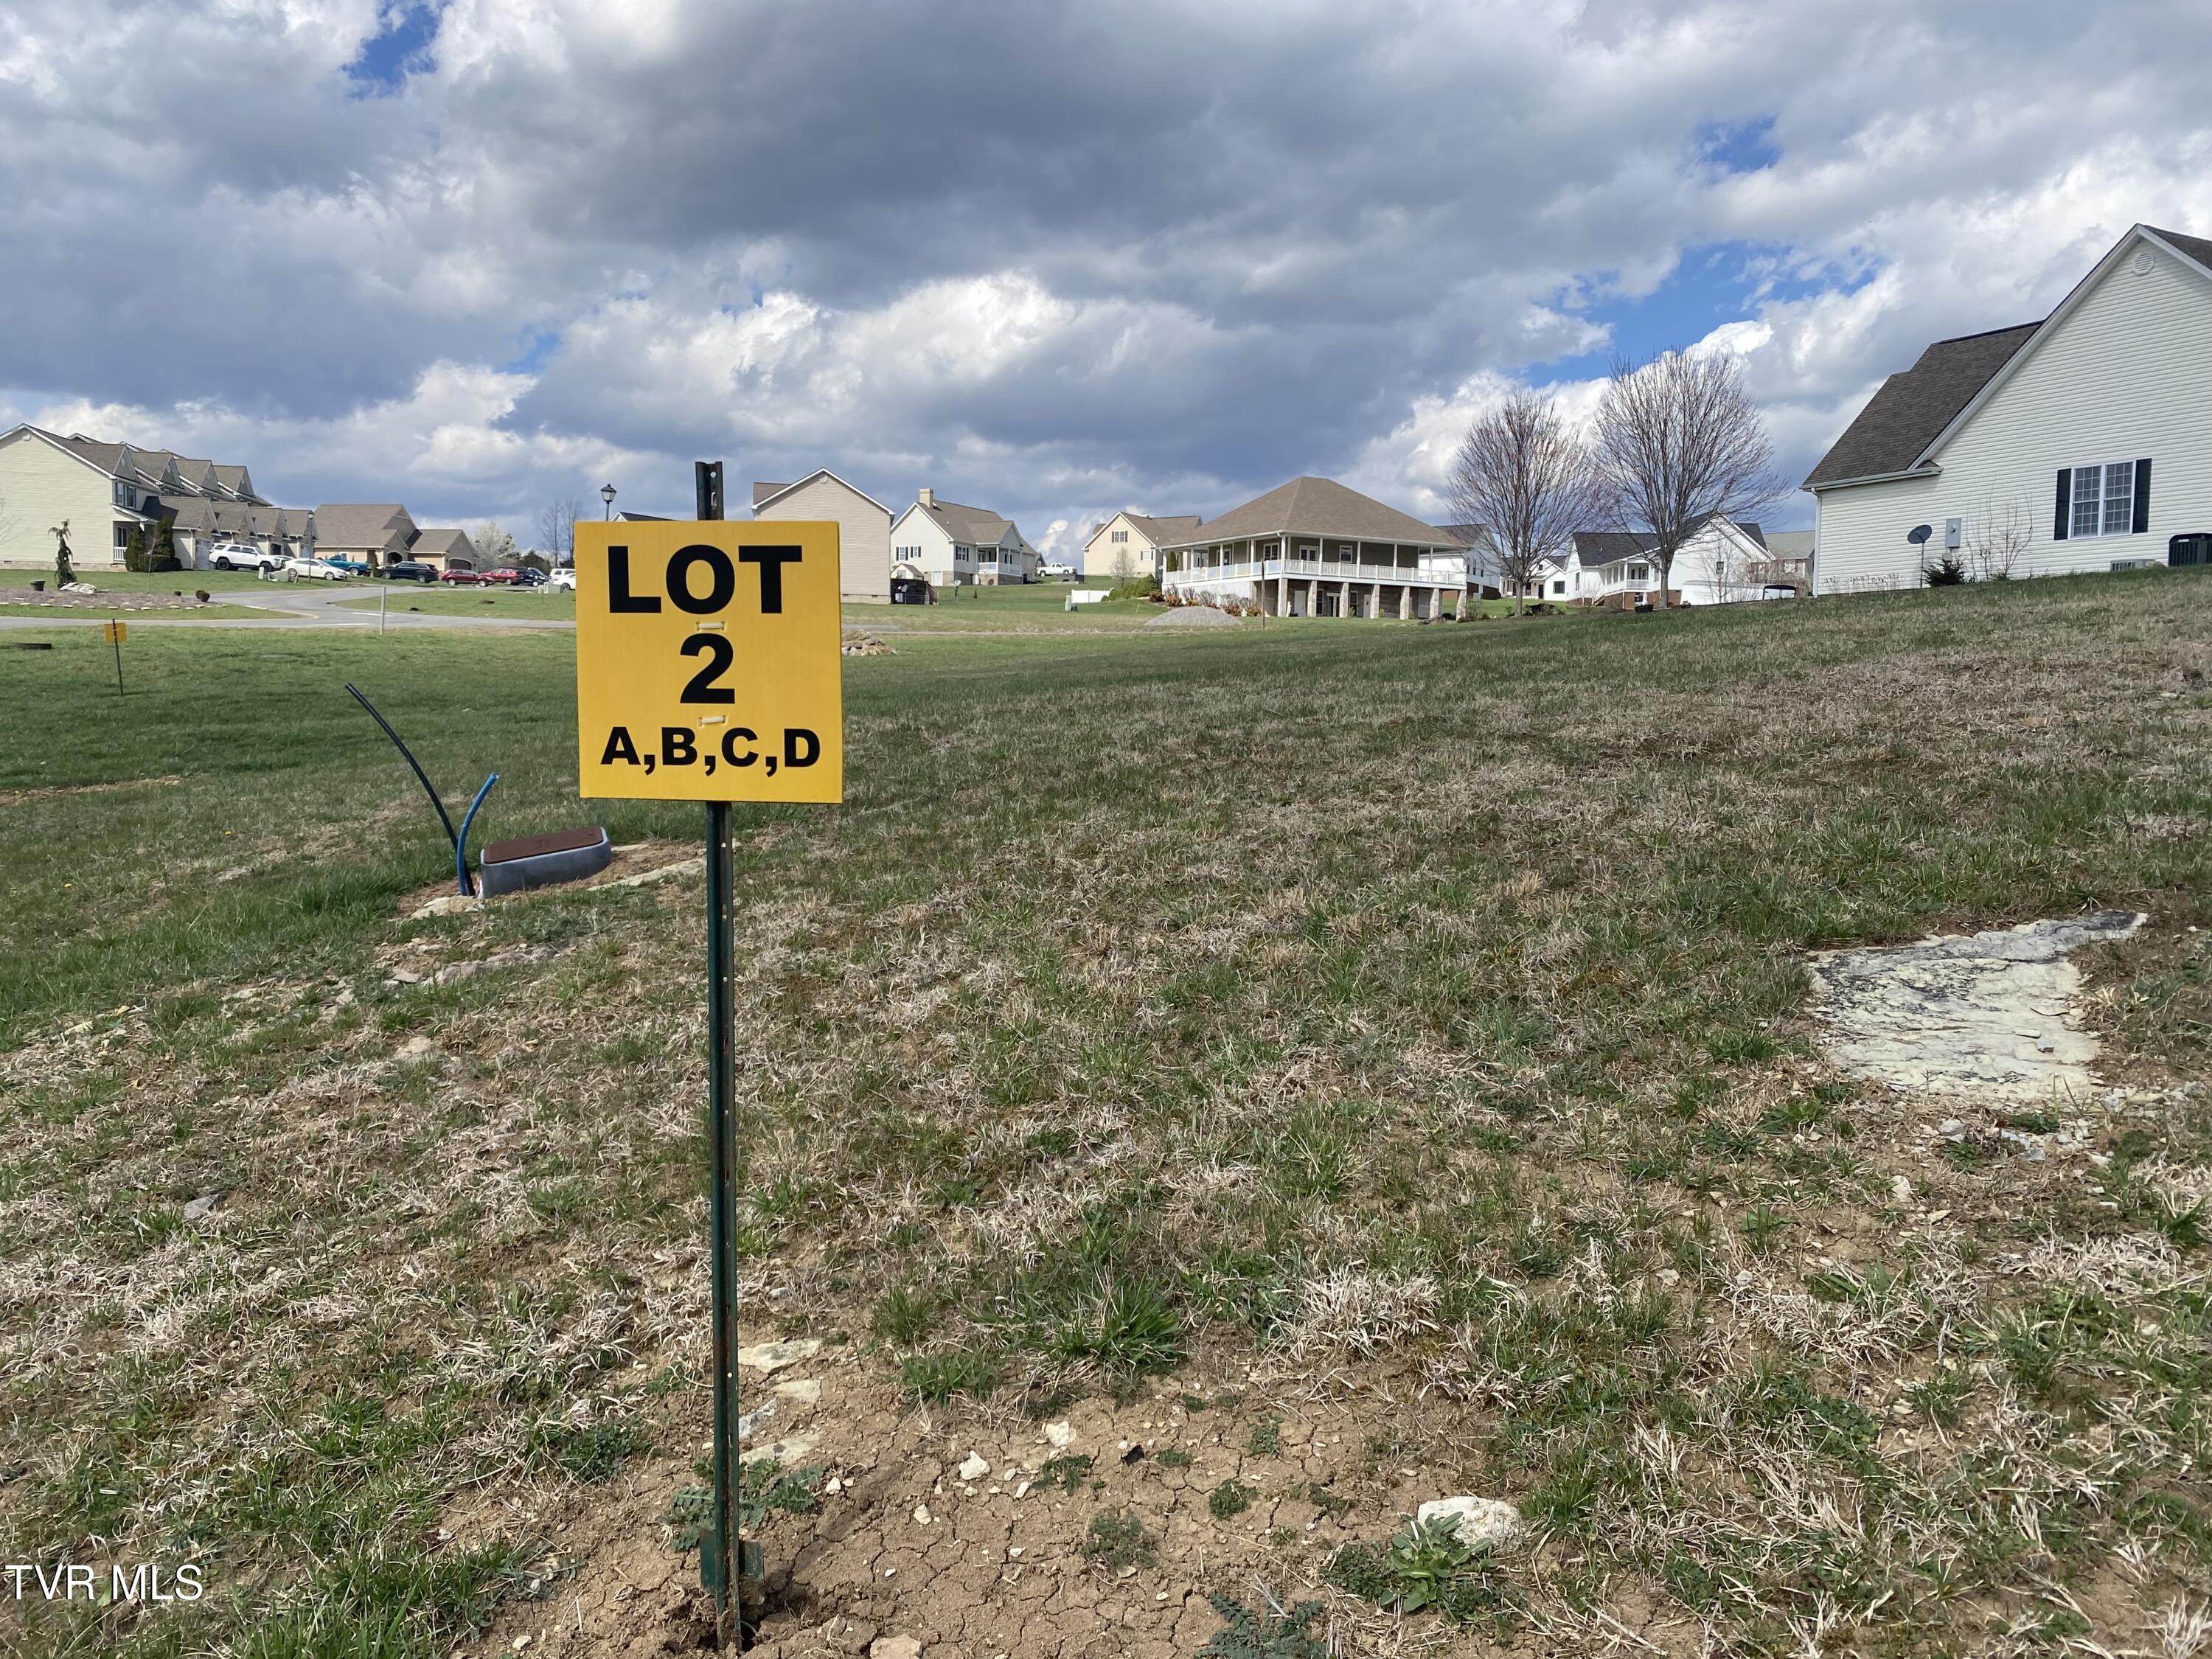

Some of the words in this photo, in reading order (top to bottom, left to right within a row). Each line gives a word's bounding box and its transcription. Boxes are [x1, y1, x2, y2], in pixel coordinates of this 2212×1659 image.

[608, 544, 802, 614] LOT
[680, 633, 735, 704] 2
[601, 726, 820, 777] A,B,C,D
